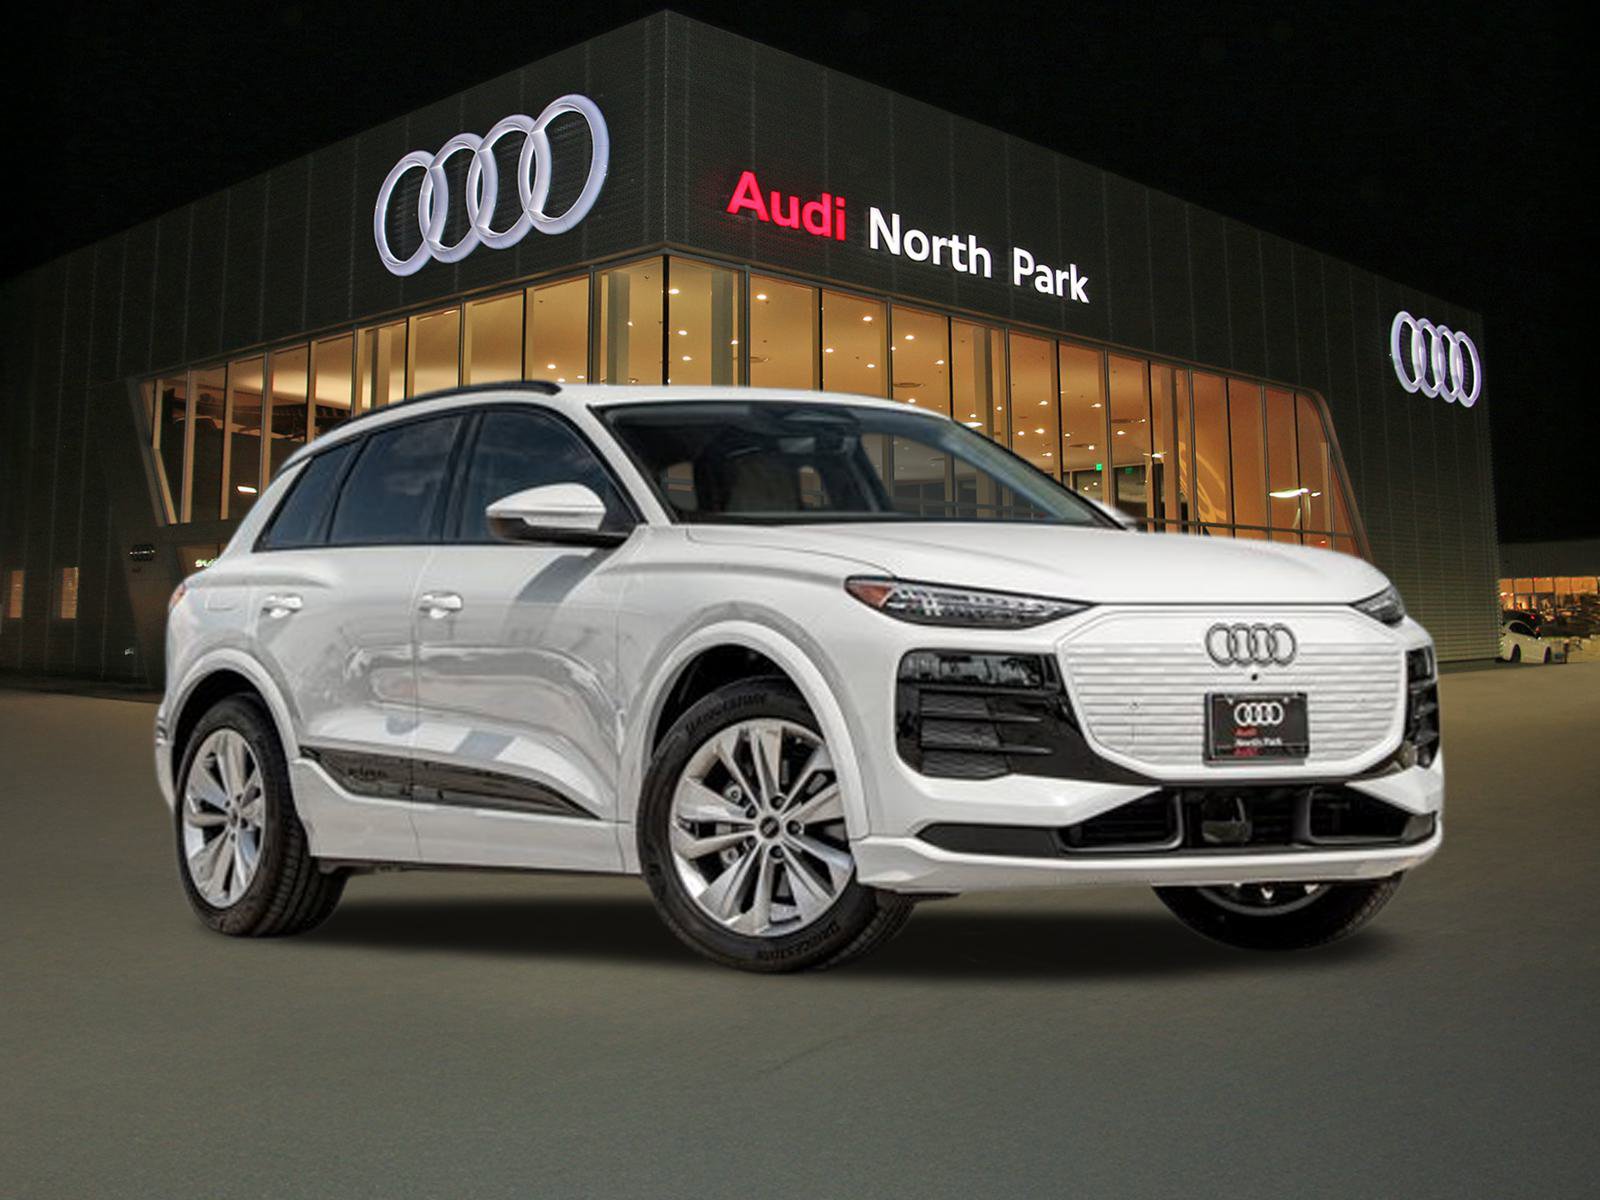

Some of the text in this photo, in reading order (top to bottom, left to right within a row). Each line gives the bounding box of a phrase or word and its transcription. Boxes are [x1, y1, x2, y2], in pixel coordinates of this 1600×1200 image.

[726, 171, 1090, 303] Audi North Park
